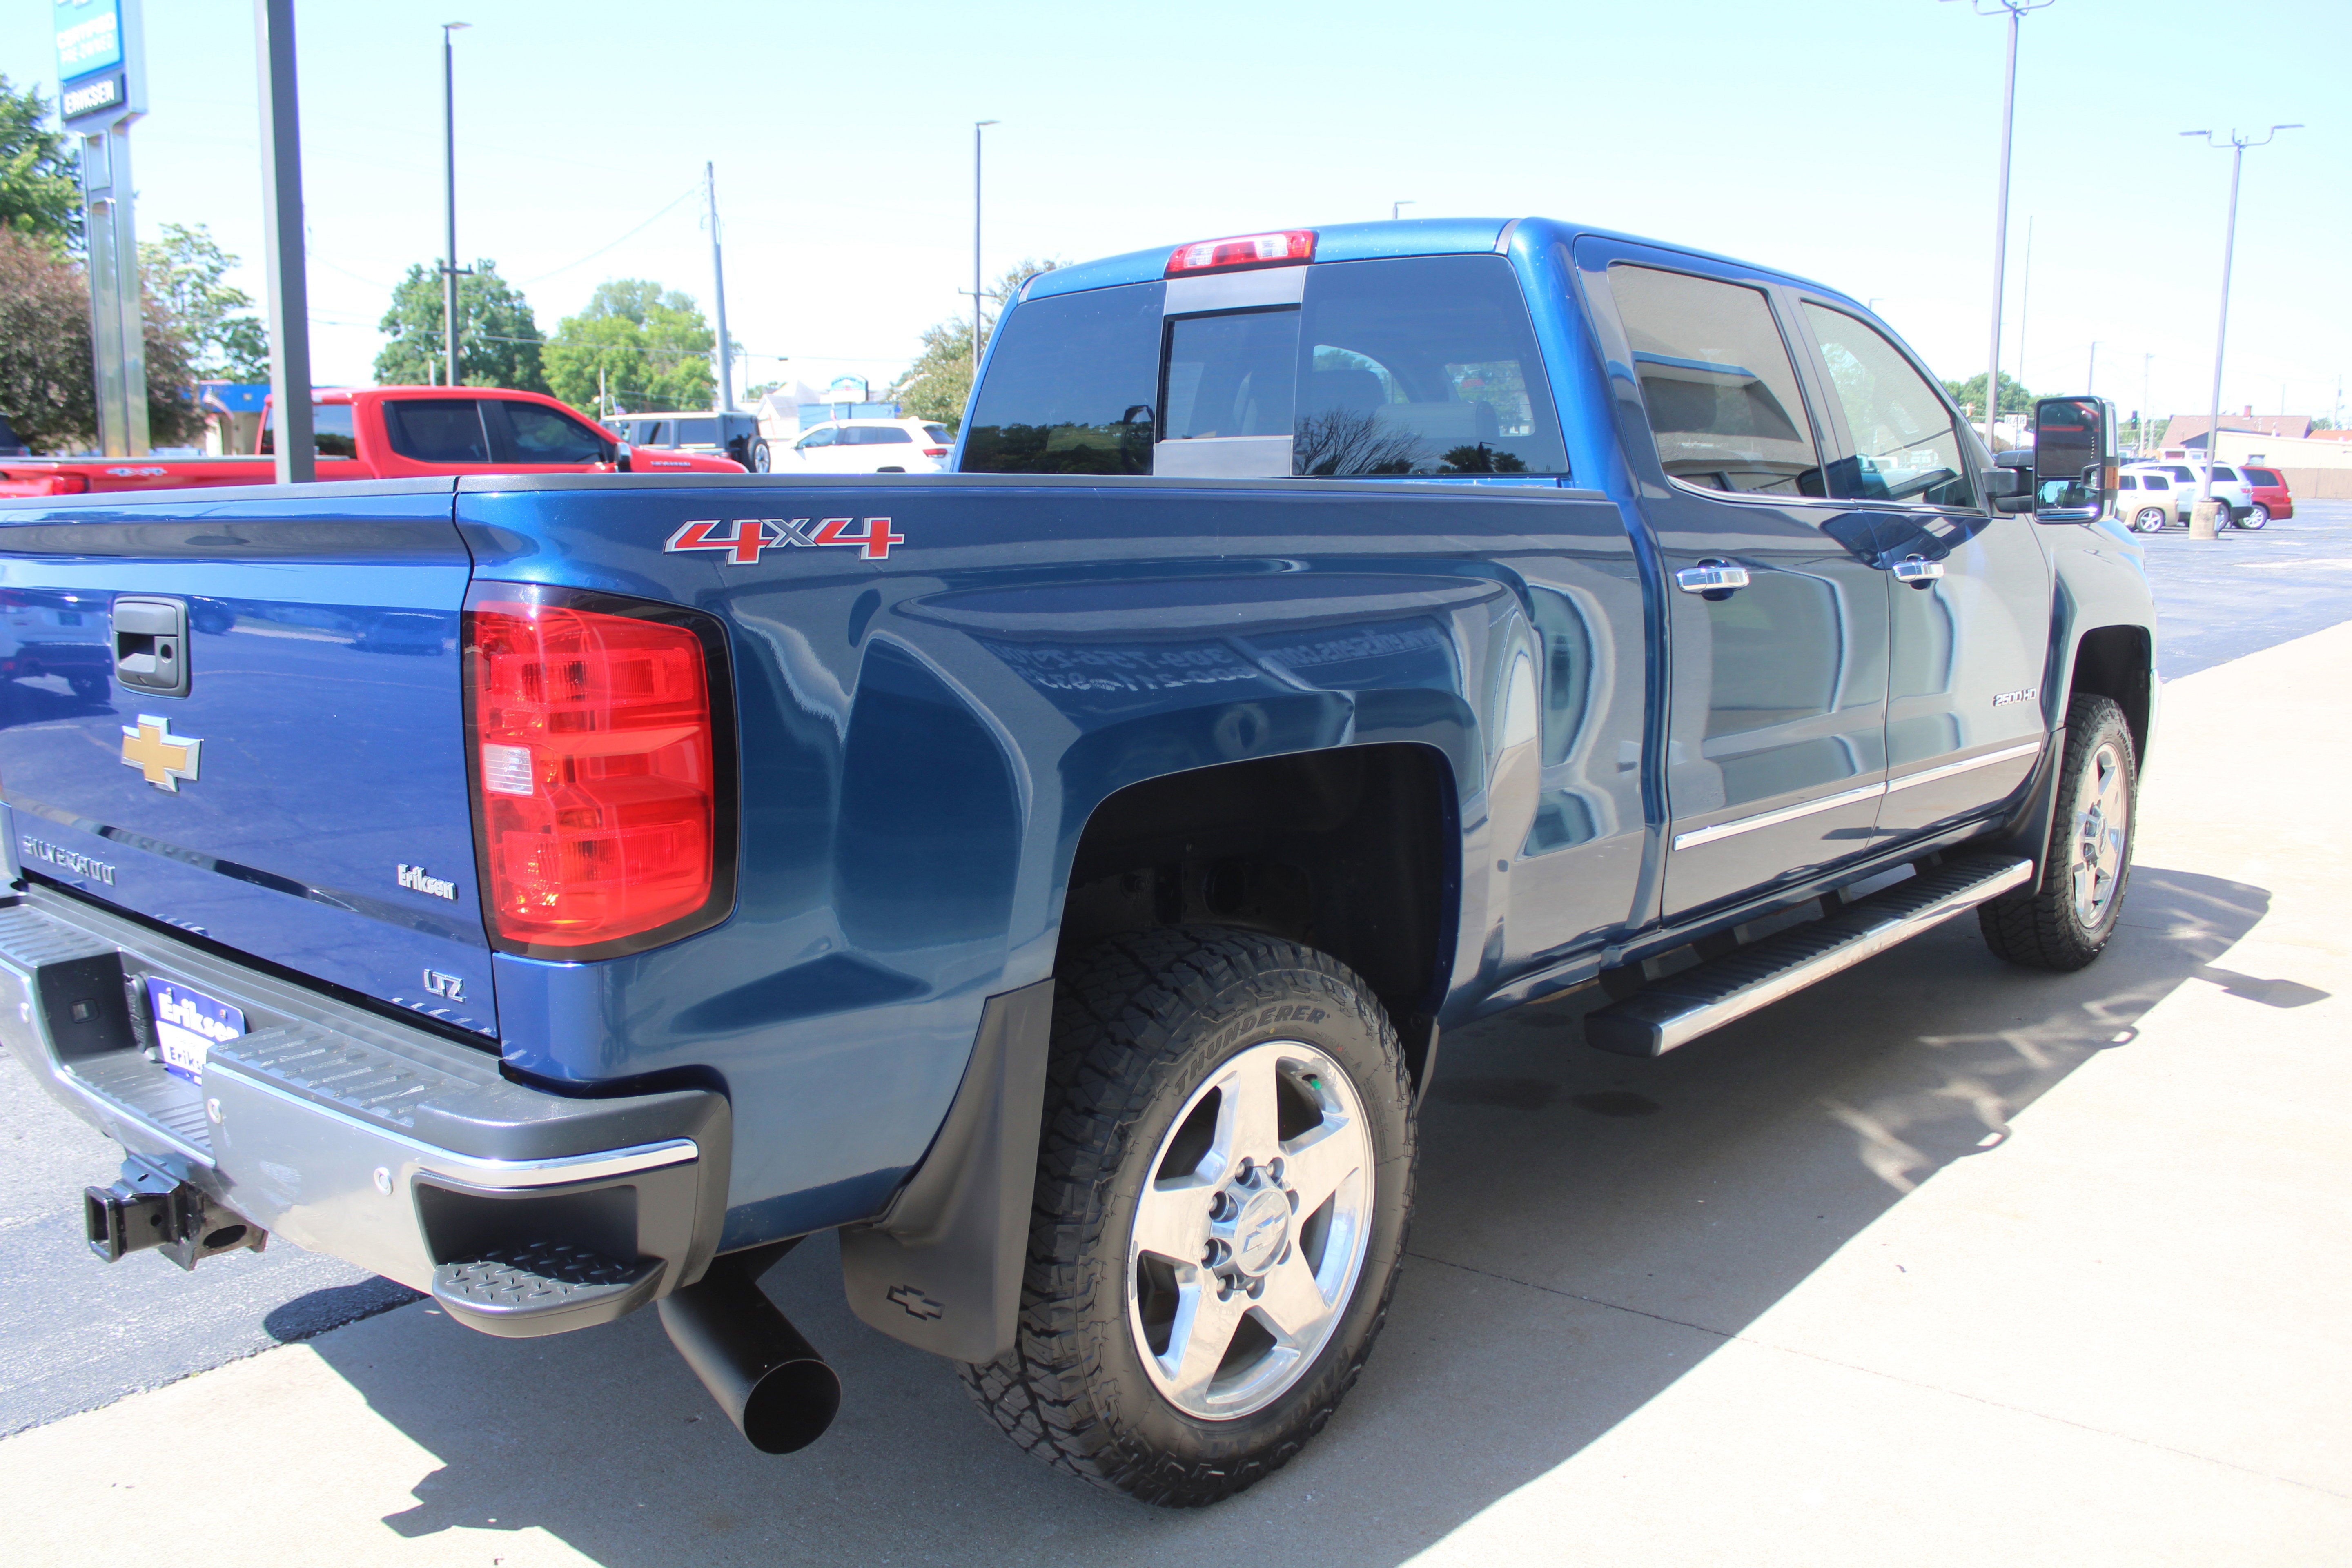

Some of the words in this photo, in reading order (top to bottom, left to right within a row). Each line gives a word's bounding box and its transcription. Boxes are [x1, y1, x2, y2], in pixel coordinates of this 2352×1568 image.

[64, 80, 115, 114] ERIKSEN
[23, 835, 116, 886] SILVERADO
[397, 863, 458, 900] Eriksen
[423, 969, 466, 1003] LTZ
[158, 992, 240, 1042] Eriksen
[1174, 1005, 1326, 1096] THUNDERER
